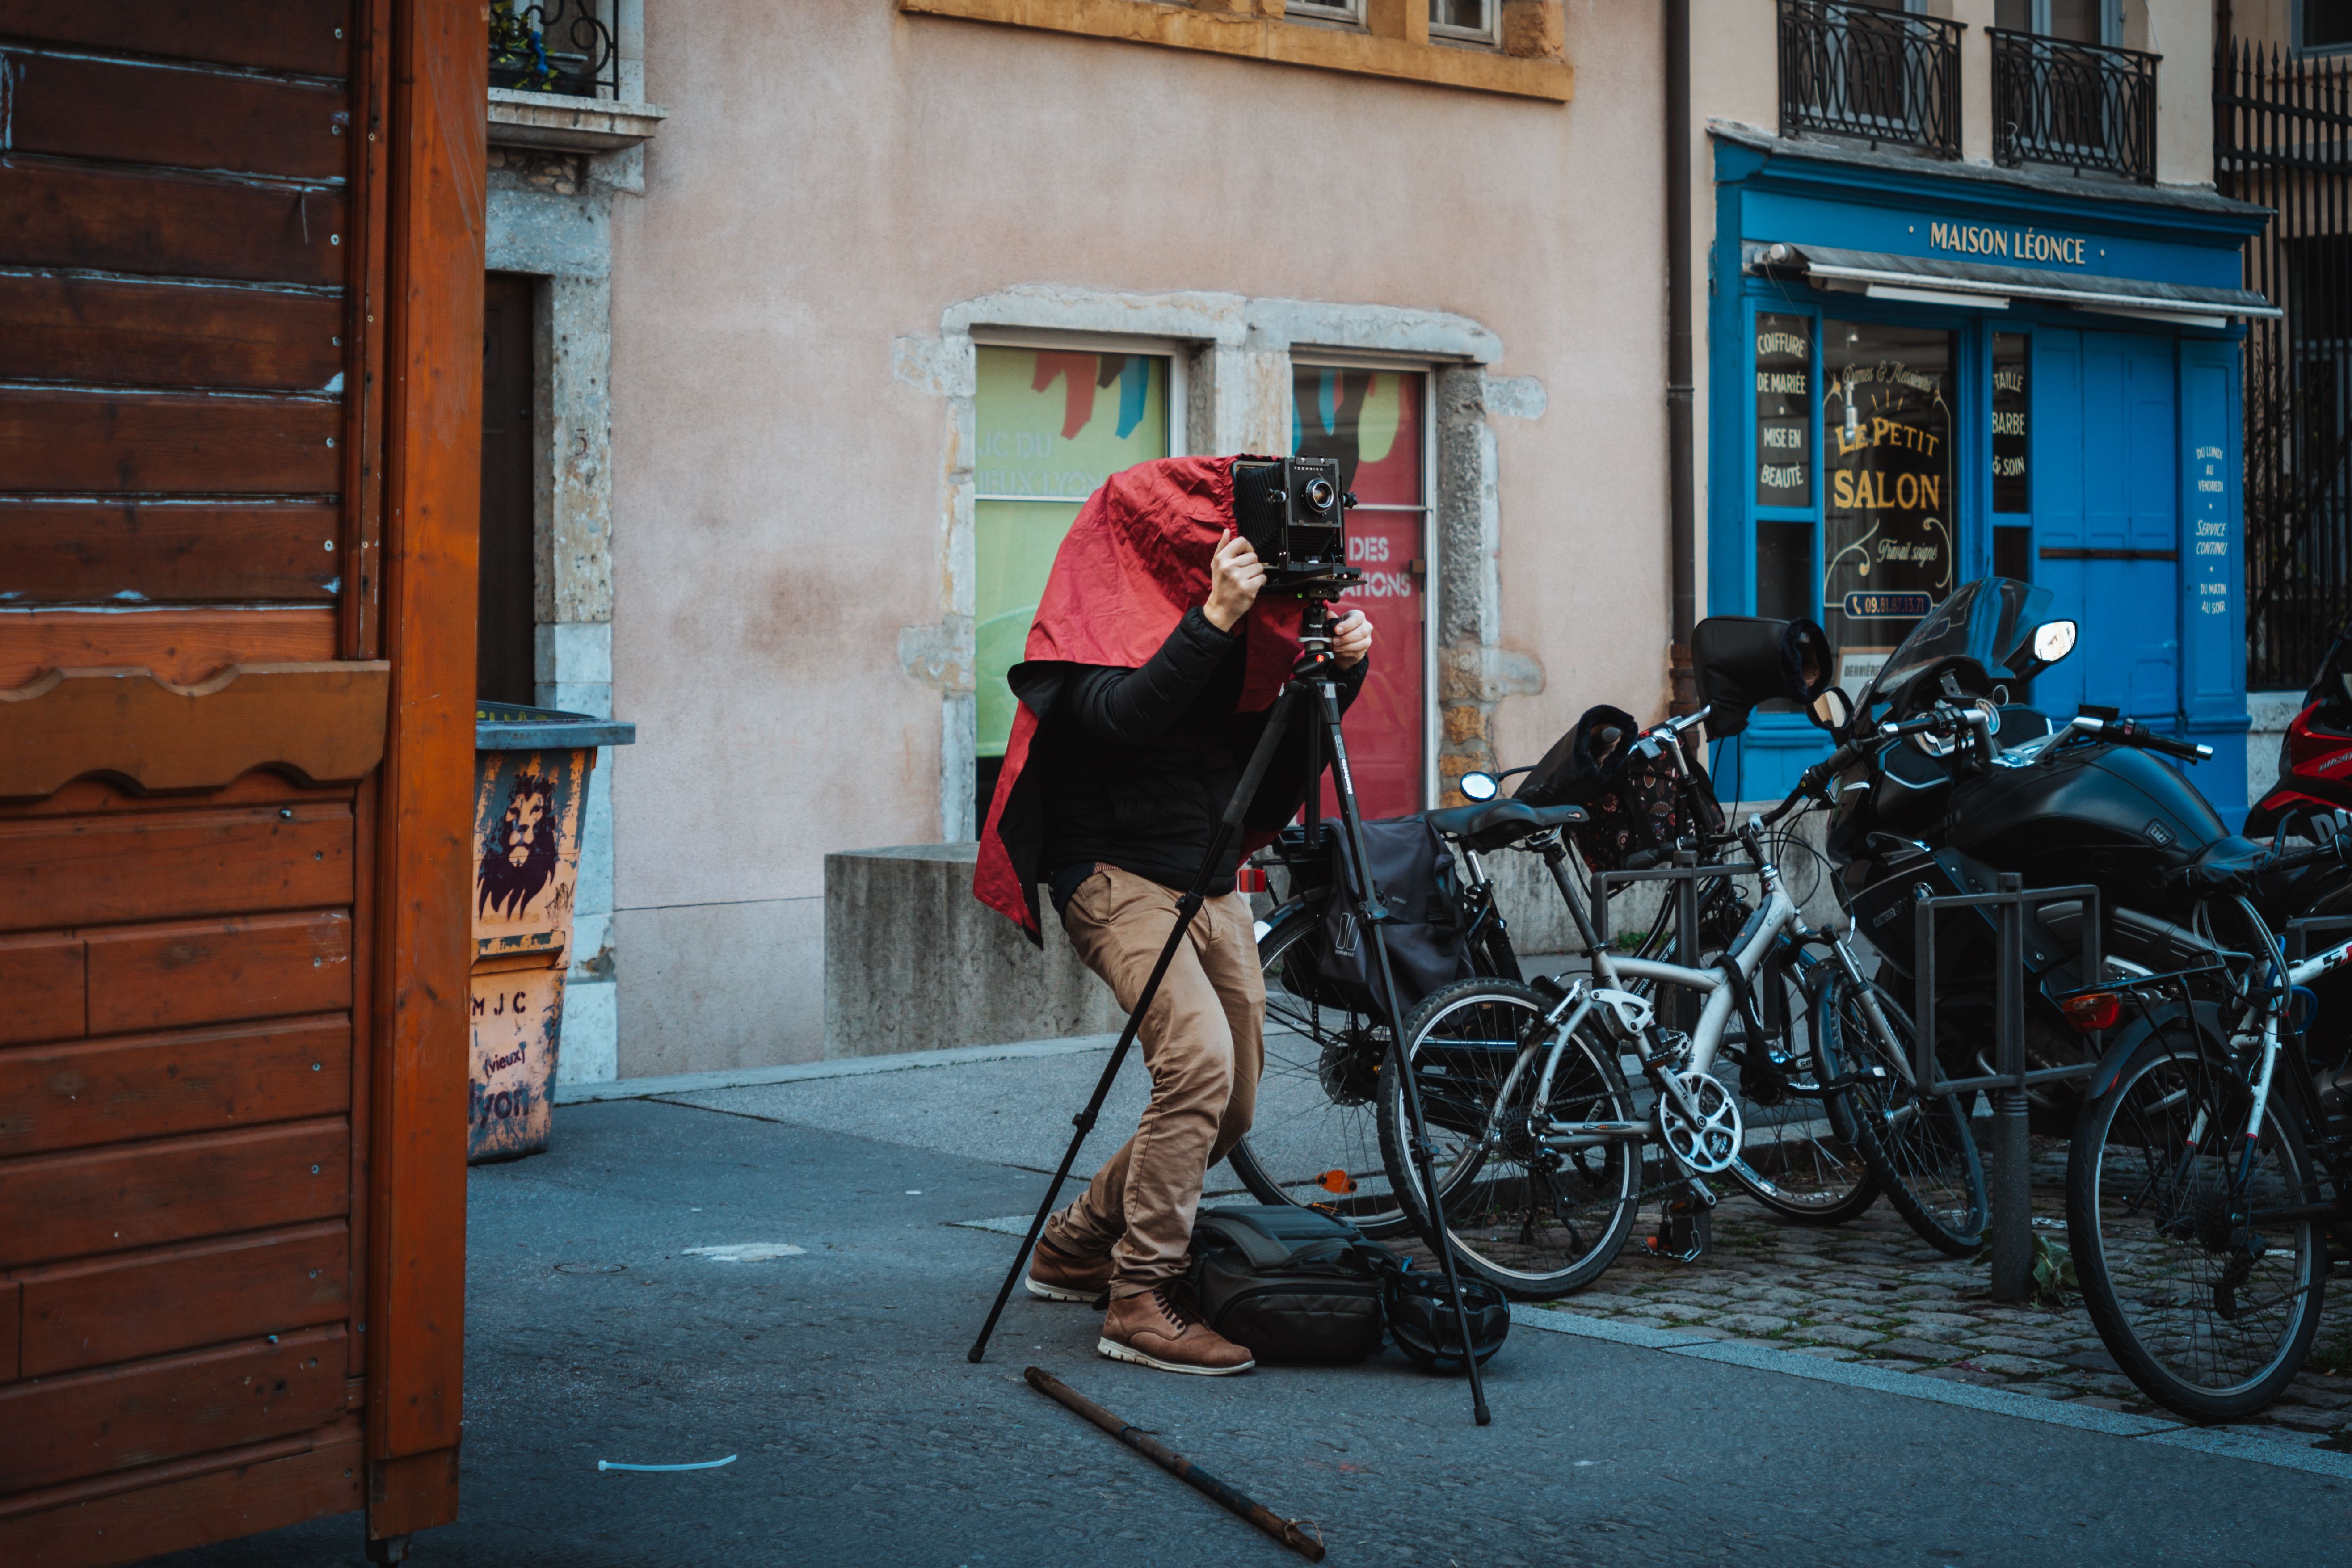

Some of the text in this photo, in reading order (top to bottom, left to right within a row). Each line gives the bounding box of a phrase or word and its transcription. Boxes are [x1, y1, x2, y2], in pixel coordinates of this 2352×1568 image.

[1931, 222, 2085, 264] MAISON LÉONCE
[1757, 332, 1805, 358] COIFFURE
[1757, 370, 1806, 394] DE MARIÉE
[1877, 360, 1887, 382] &
[1993, 371, 2024, 393] TAILLE
[1992, 412, 2025, 435] BARBE
[575, 428, 587, 456] 5
[1016, 432, 1052, 458] DU
[1763, 427, 1801, 448] MISE EN
[1872, 417, 1940, 457] PETIT
[2196, 446, 2224, 461] DU LUNDI
[1760, 461, 1804, 488] BEAUTÉ
[1993, 455, 2025, 476] & SOIN
[2206, 465, 2214, 476] AU
[1042, 471, 1104, 496] LYON
[1834, 469, 1940, 511] SALON
[2198, 480, 2224, 492] VENDREDI
[2196, 519, 2227, 537] SERVICE
[1349, 537, 1389, 562] DES
[1877, 538, 1911, 563] Travail
[2196, 541, 2228, 556] CONTINU
[2201, 583, 2226, 595] DU MATIN
[2202, 600, 2226, 614] AU SOIR
[1341, 758, 1353, 794] Manfrotto
